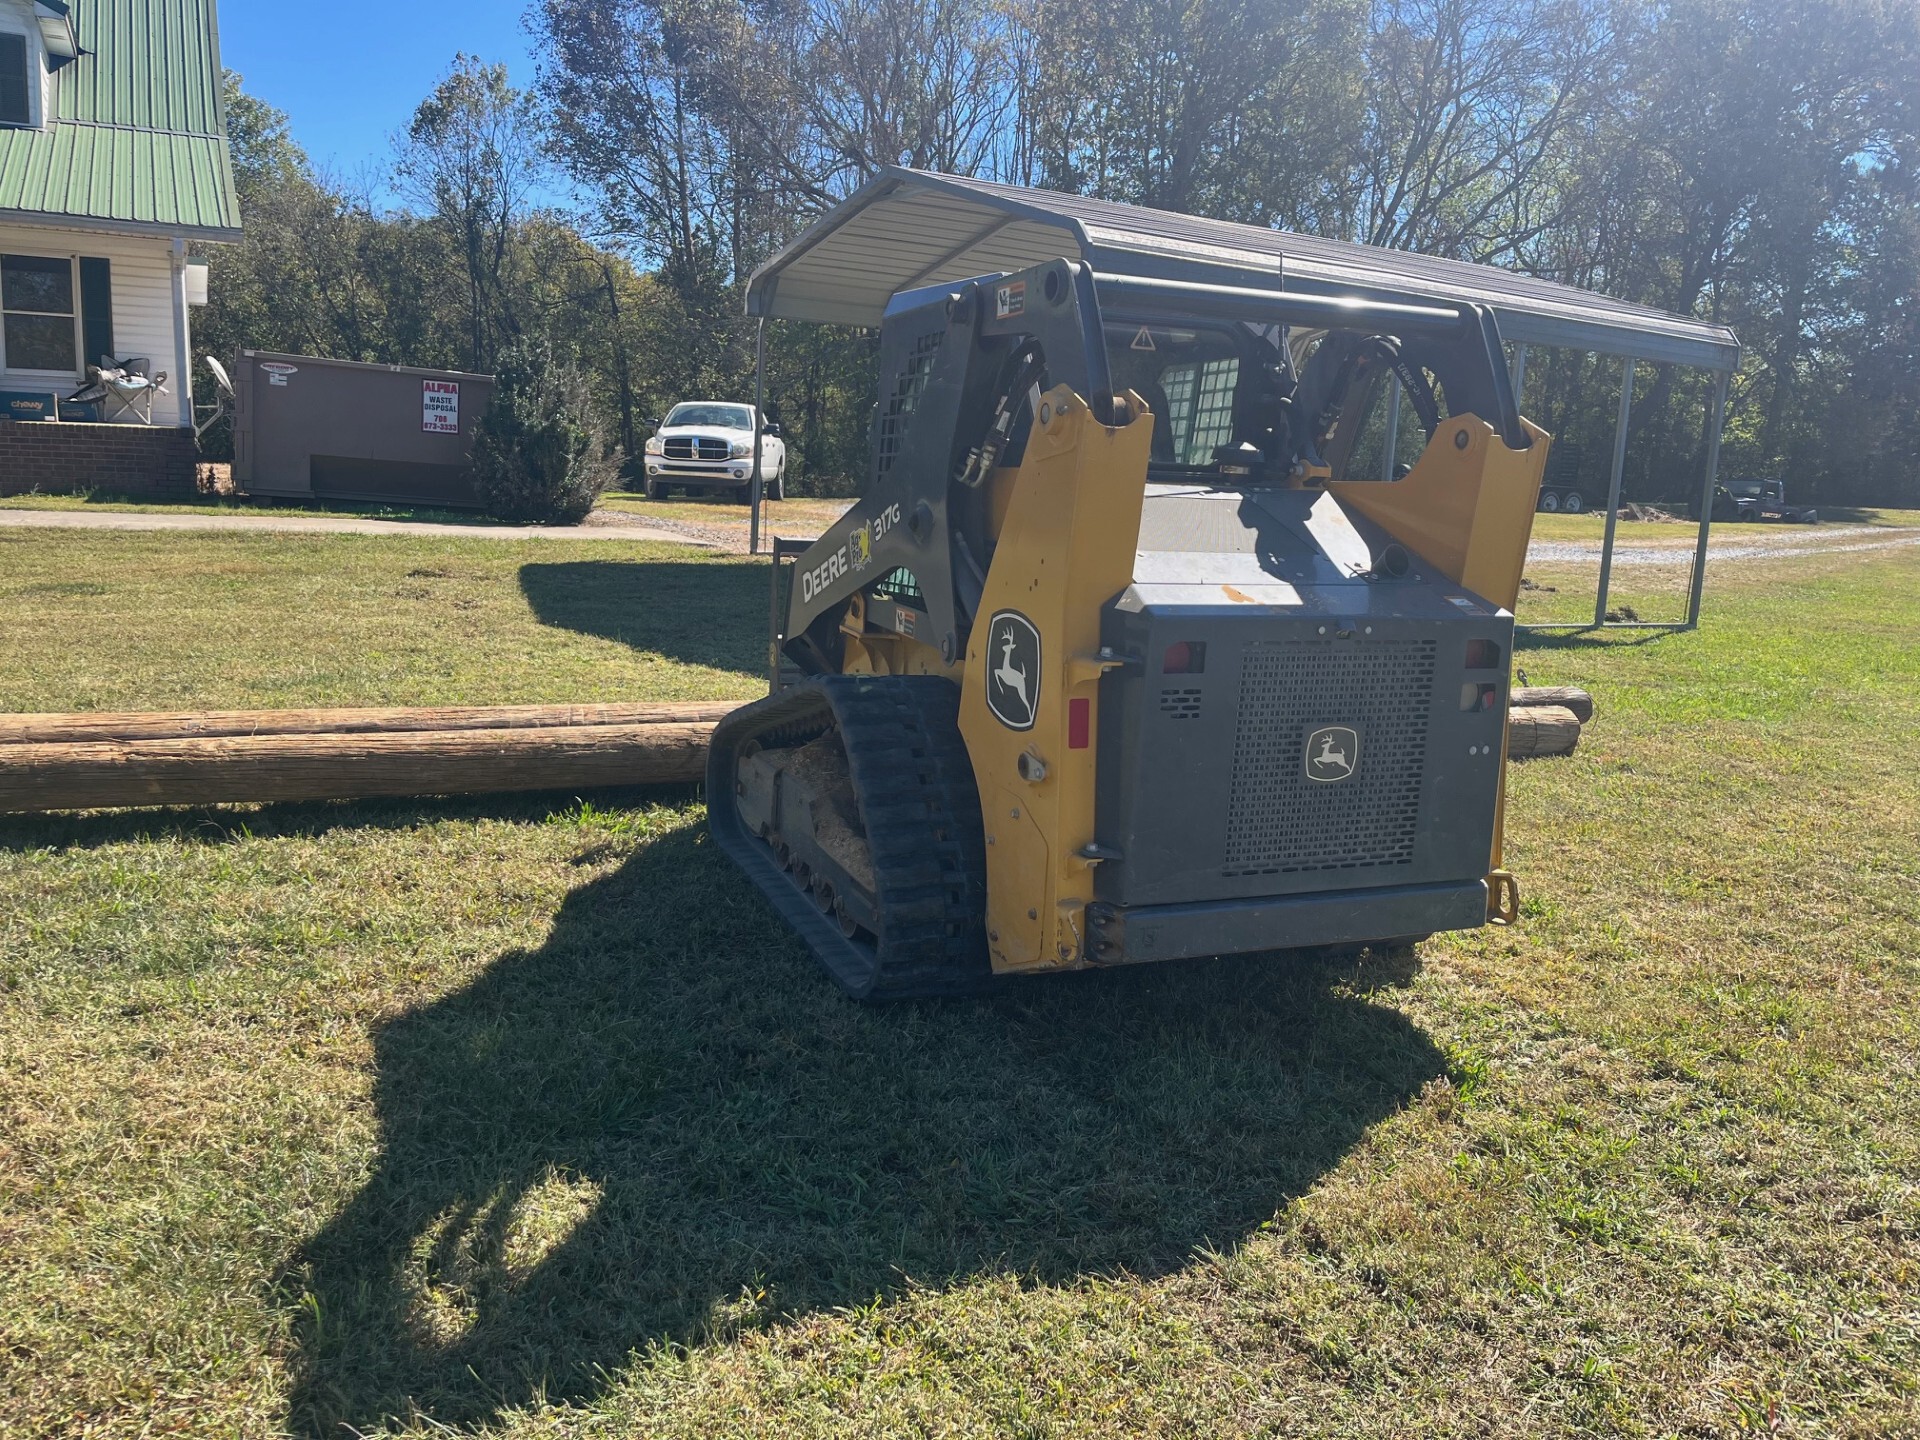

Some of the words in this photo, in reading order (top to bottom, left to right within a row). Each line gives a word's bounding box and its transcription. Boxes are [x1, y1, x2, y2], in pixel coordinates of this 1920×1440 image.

[424, 382, 458, 394] ALPHA
[11, 400, 44, 410] chewy
[429, 396, 453, 404] WASTE
[424, 403, 457, 412] DISPOSAL
[873, 503, 900, 541] 317G
[802, 545, 848, 603] DEERE
